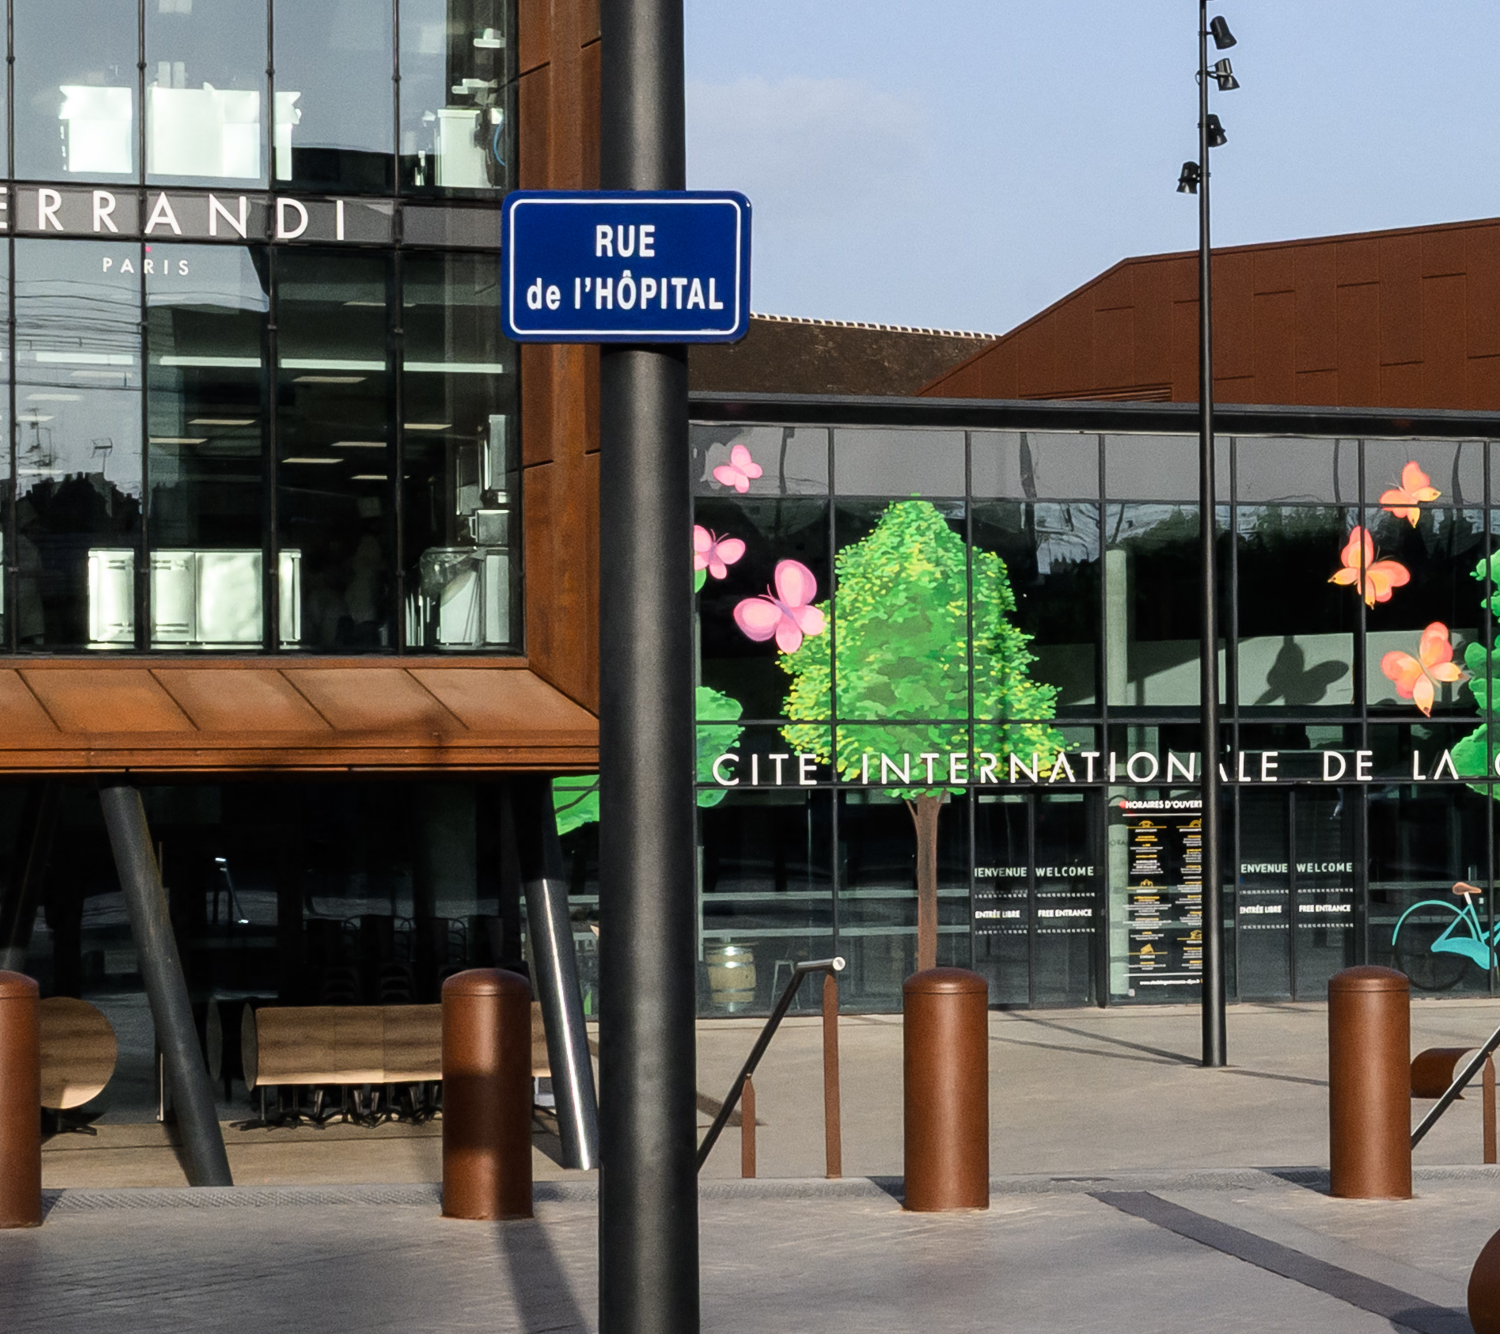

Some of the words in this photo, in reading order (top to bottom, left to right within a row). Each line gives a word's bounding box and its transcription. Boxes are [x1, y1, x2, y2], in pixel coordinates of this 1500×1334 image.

[596, 225, 655, 257] RUE
[102, 257, 190, 276] PARIS
[527, 278, 561, 310] de
[575, 270, 724, 310] l'HÔPITAL
[712, 753, 818, 786] CITE
[1323, 750, 1373, 781] DE
[1413, 748, 1459, 780] LA
[1125, 800, 1163, 809] HORAIRES
[974, 867, 1027, 877] IENVENUE
[1035, 866, 1094, 877] WELCOME
[1240, 863, 1288, 873] ENVENUE
[1296, 862, 1352, 873] WELCOME
[975, 908, 1001, 919] ENTRÉE
[1002, 910, 1020, 918] LIBRE
[1038, 909, 1054, 917] FREE
[1055, 908, 1092, 917] ENTRANCE
[1316, 904, 1351, 912] ENTRANCE
